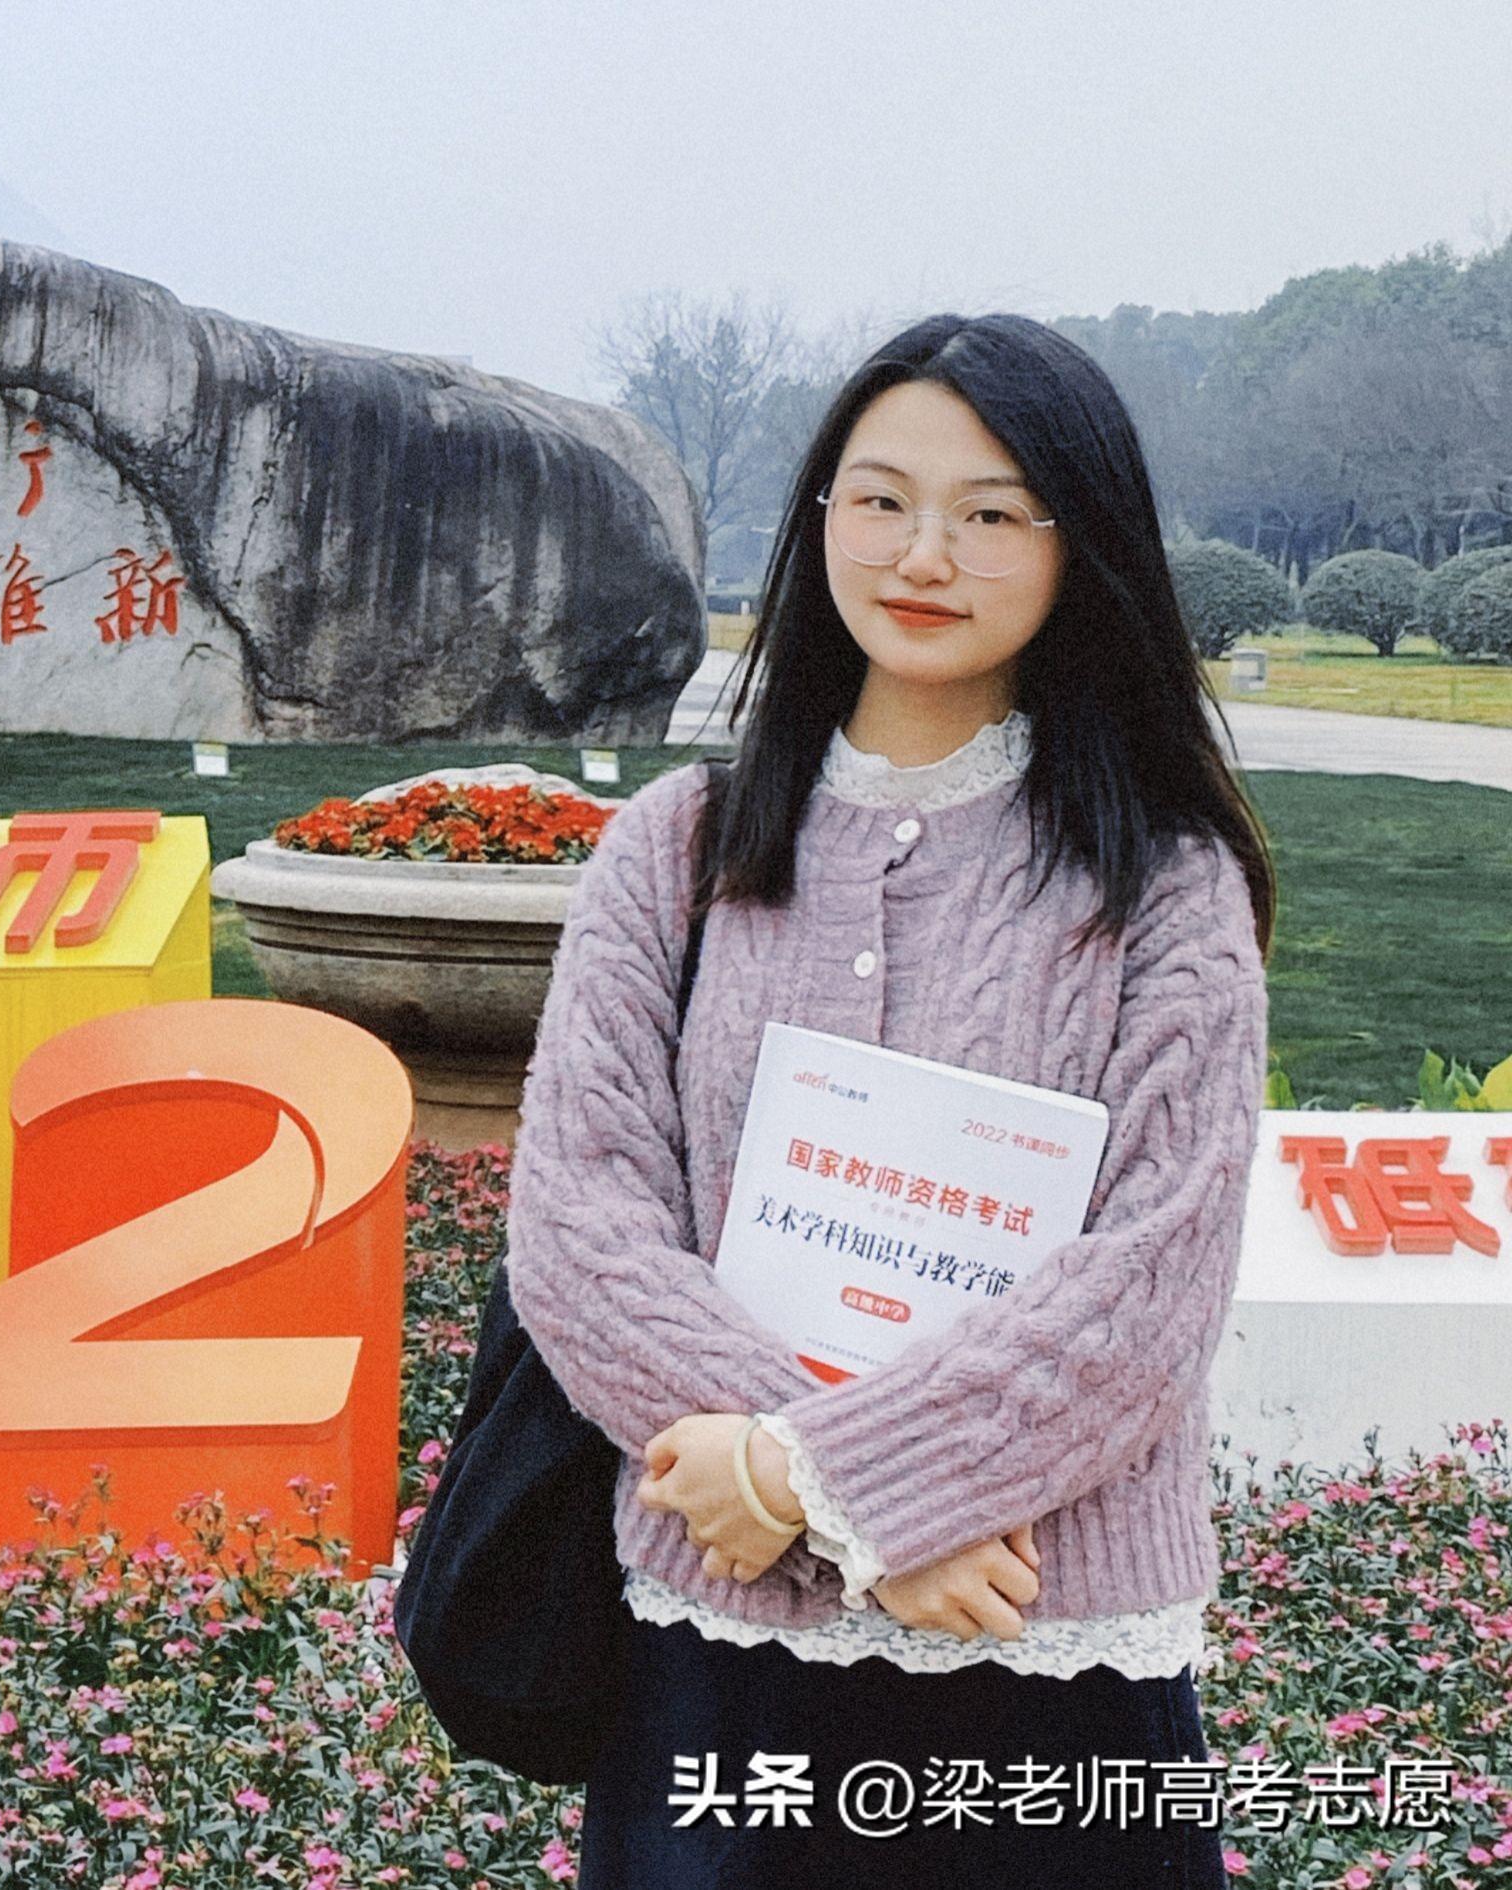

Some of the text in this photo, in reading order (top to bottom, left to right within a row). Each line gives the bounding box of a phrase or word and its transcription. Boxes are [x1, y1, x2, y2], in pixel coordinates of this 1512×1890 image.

[961, 1118, 1007, 1143] 2022
[786, 1138, 1036, 1237] 国家教师资格考试
[1280, 1135, 1512, 1258] 砥
